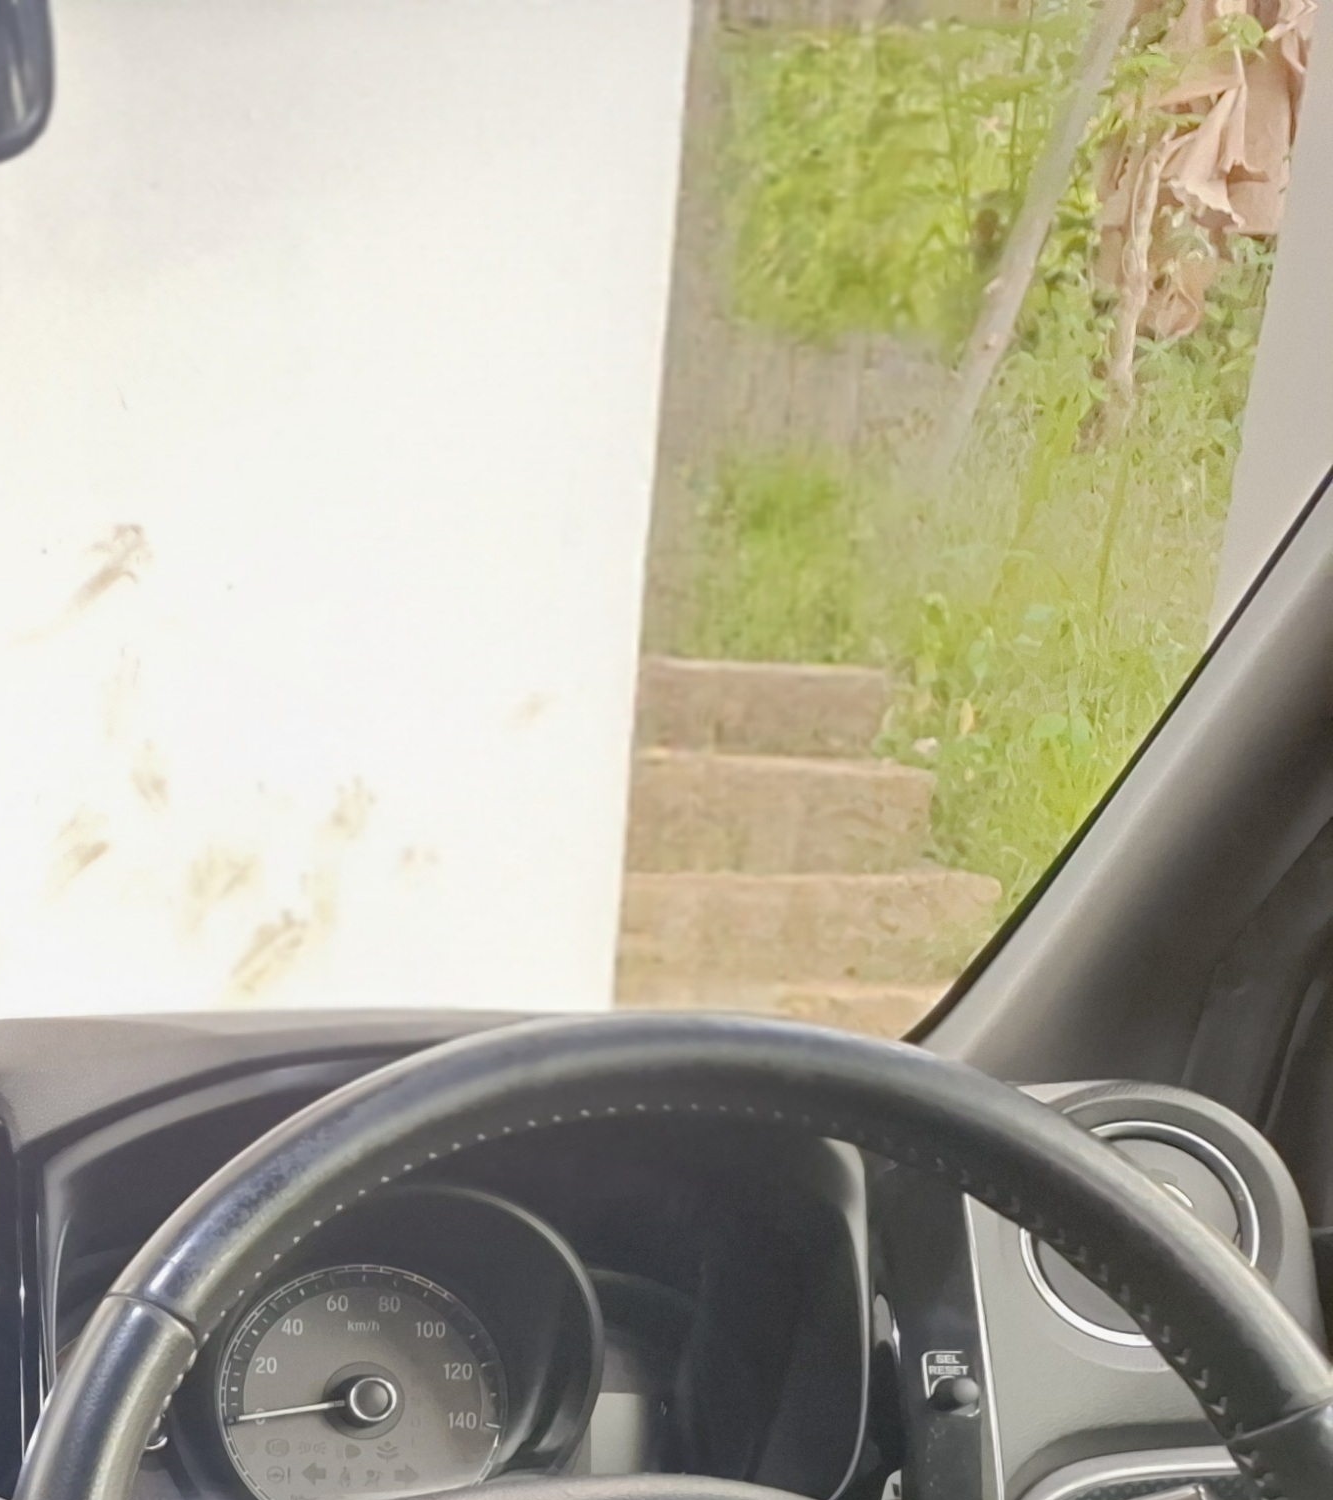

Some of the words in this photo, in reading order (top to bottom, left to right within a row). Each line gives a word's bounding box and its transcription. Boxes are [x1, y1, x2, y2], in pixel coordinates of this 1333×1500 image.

[326, 1295, 349, 1312] 60
[378, 1296, 401, 1313] 80
[281, 1318, 304, 1336] 40
[347, 1320, 380, 1332] km/h
[416, 1321, 446, 1338] 100
[255, 1357, 277, 1375] 20
[444, 1363, 473, 1380] 120
[448, 1412, 477, 1429] 140
